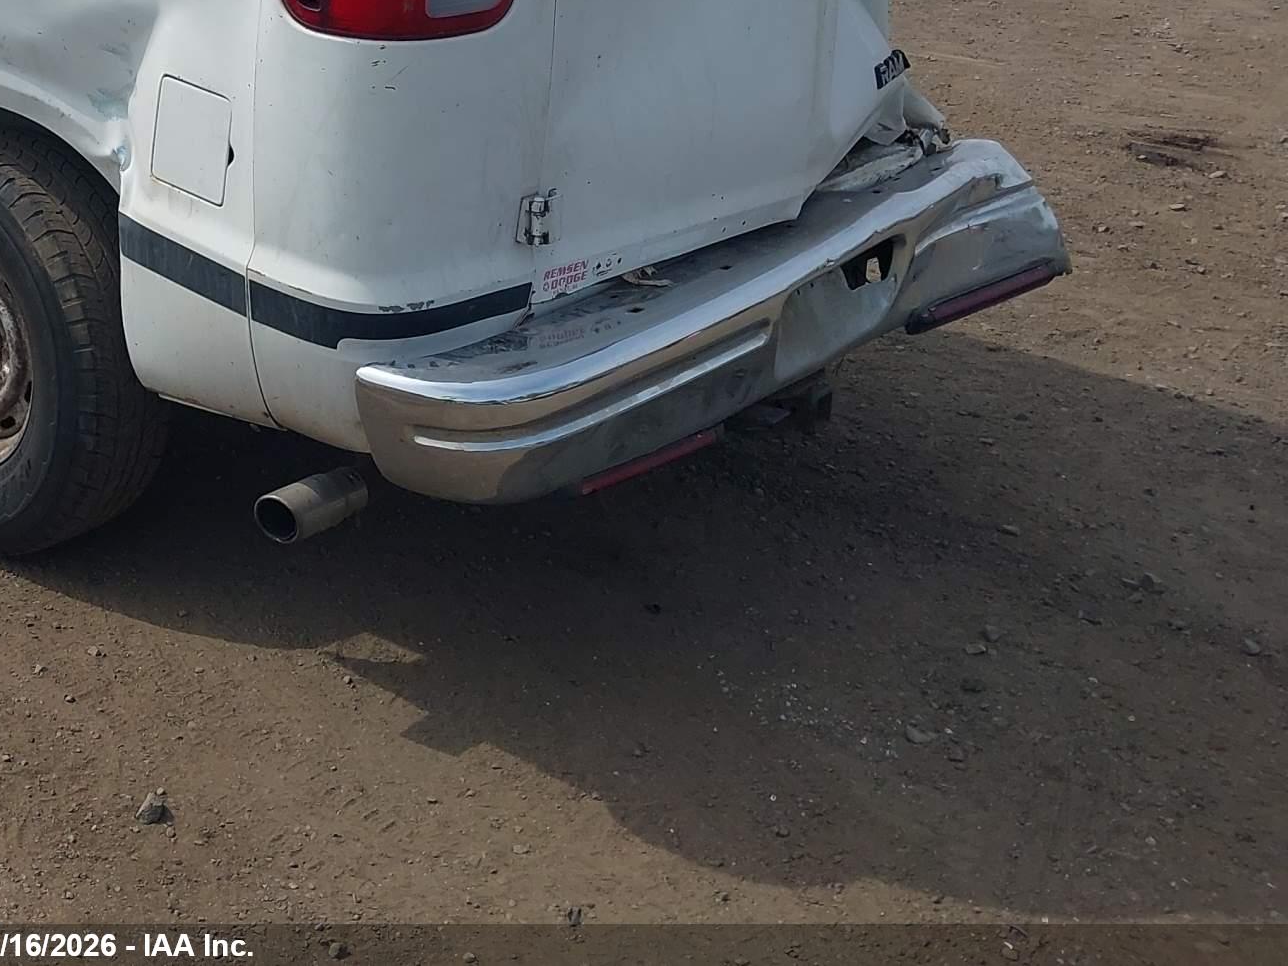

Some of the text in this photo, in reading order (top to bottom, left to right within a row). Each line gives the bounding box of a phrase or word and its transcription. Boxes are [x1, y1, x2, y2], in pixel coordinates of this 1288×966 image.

[878, 50, 907, 87] RAM
[543, 259, 590, 281] REMSEN
[550, 270, 588, 291] DODGE
